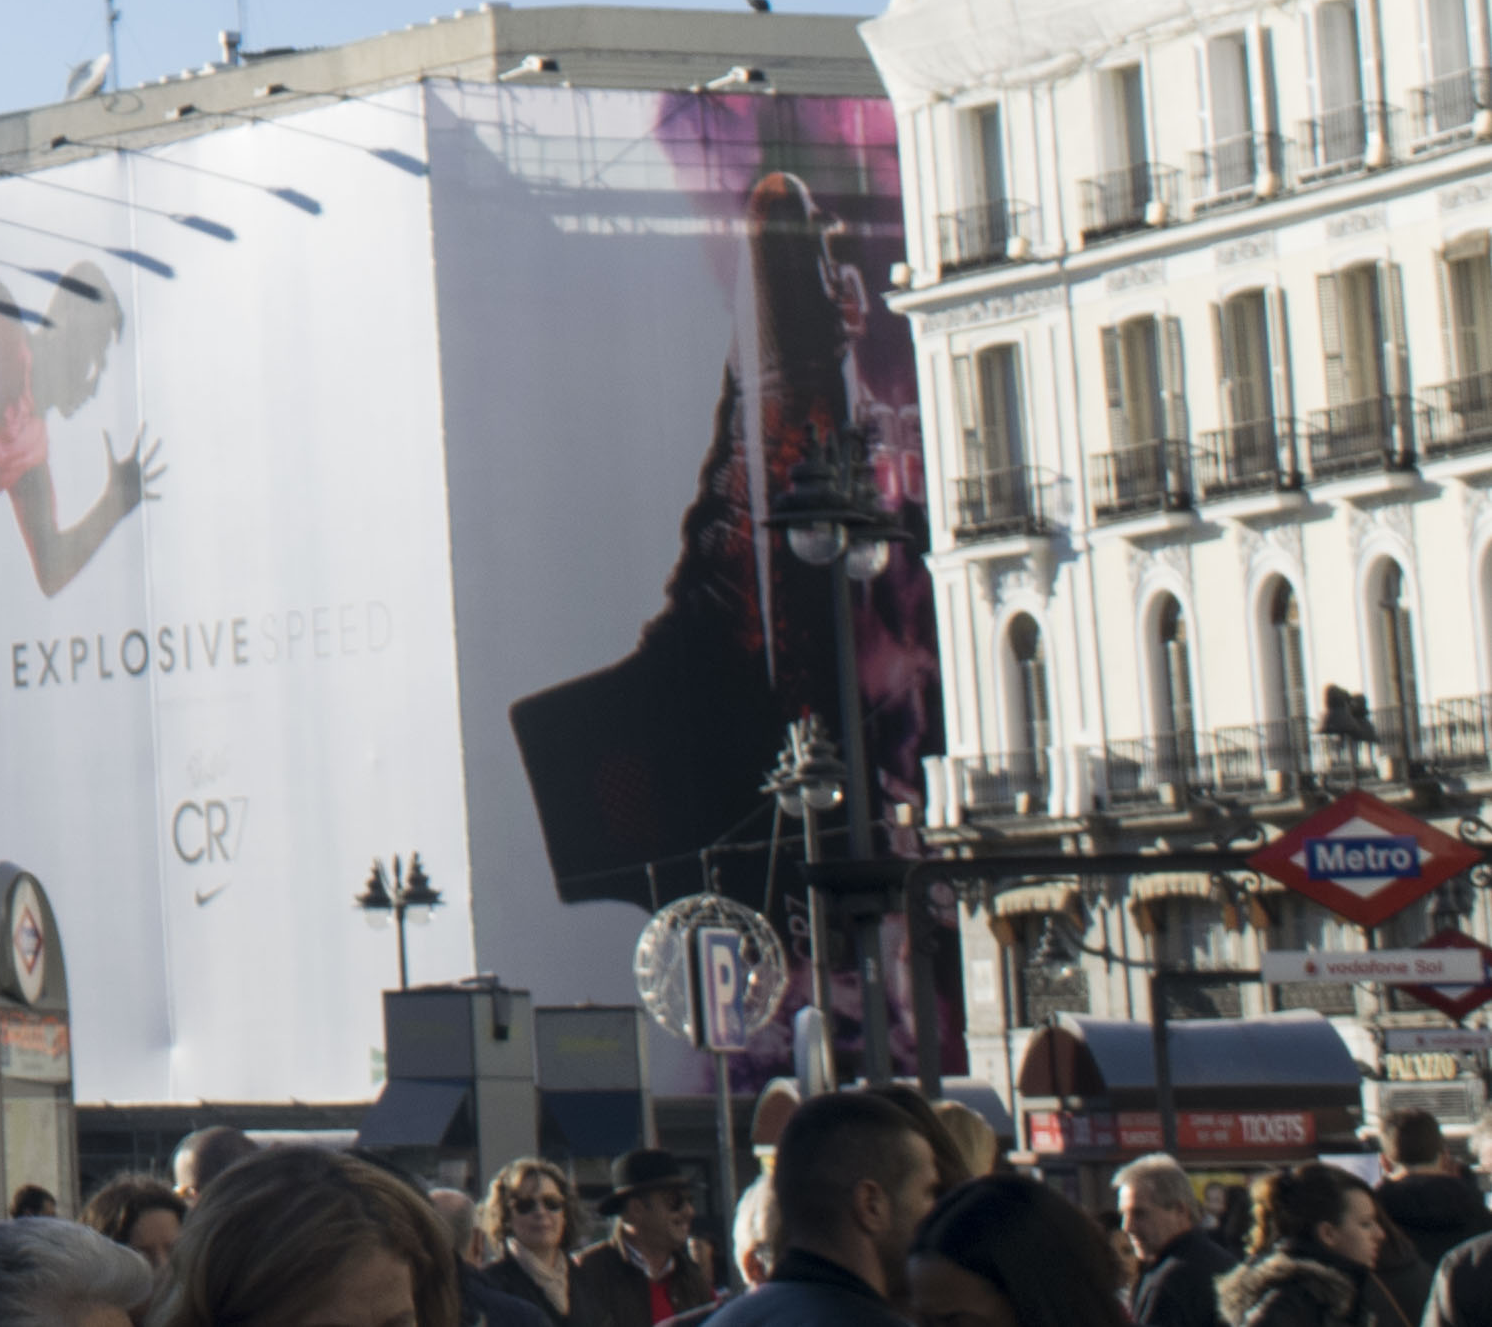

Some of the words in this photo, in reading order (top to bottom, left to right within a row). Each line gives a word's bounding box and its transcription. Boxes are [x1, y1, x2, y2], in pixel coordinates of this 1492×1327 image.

[12, 617, 250, 689] EXPLOSIVE
[259, 599, 393, 665] SPEED
[173, 795, 249, 865] CR7
[1313, 843, 1411, 871] Metro
[712, 945, 737, 1040] P
[1238, 1113, 1306, 1144] TICKETS
